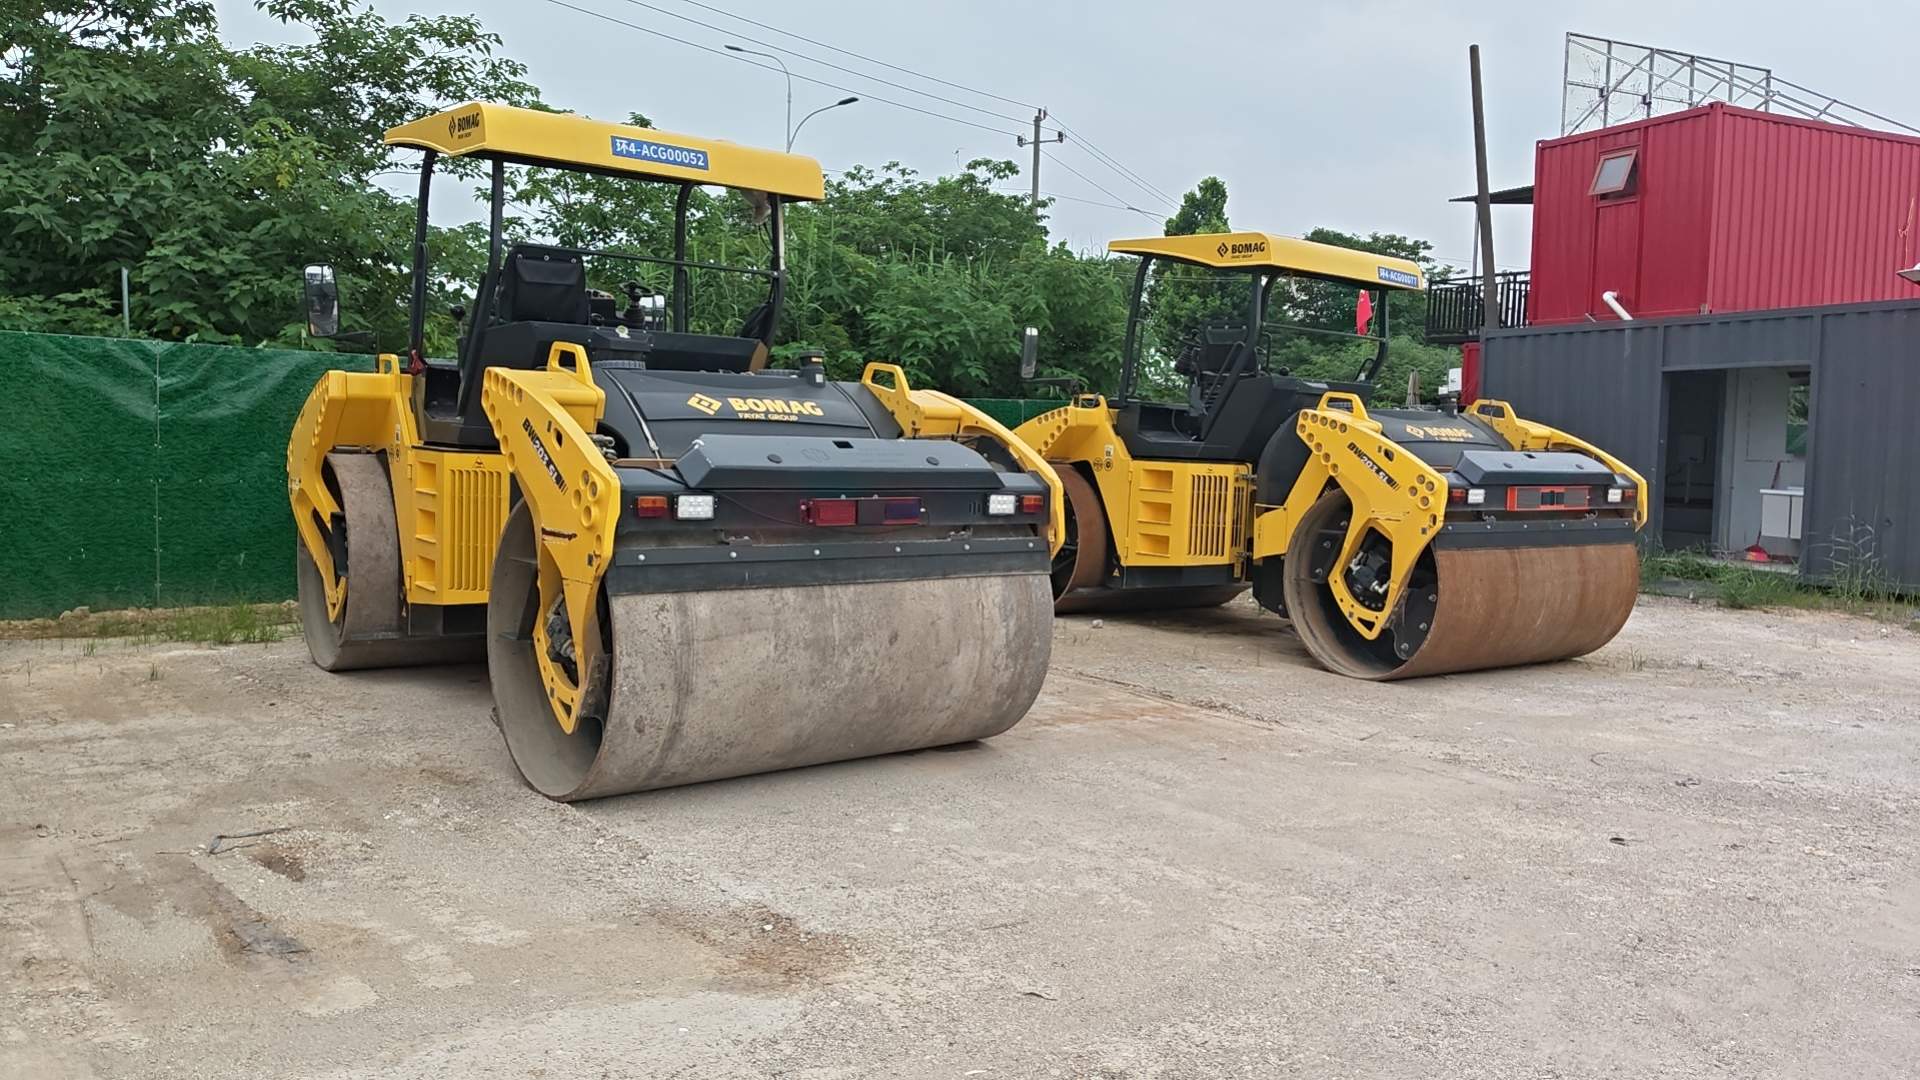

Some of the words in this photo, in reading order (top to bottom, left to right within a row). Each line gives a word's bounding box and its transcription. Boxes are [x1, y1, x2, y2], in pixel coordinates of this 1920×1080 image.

[458, 112, 480, 132] BOMAG
[615, 139, 705, 166] 环4-ACG00052
[1231, 241, 1266, 254] BOMAG
[727, 397, 825, 416] BOMAG
